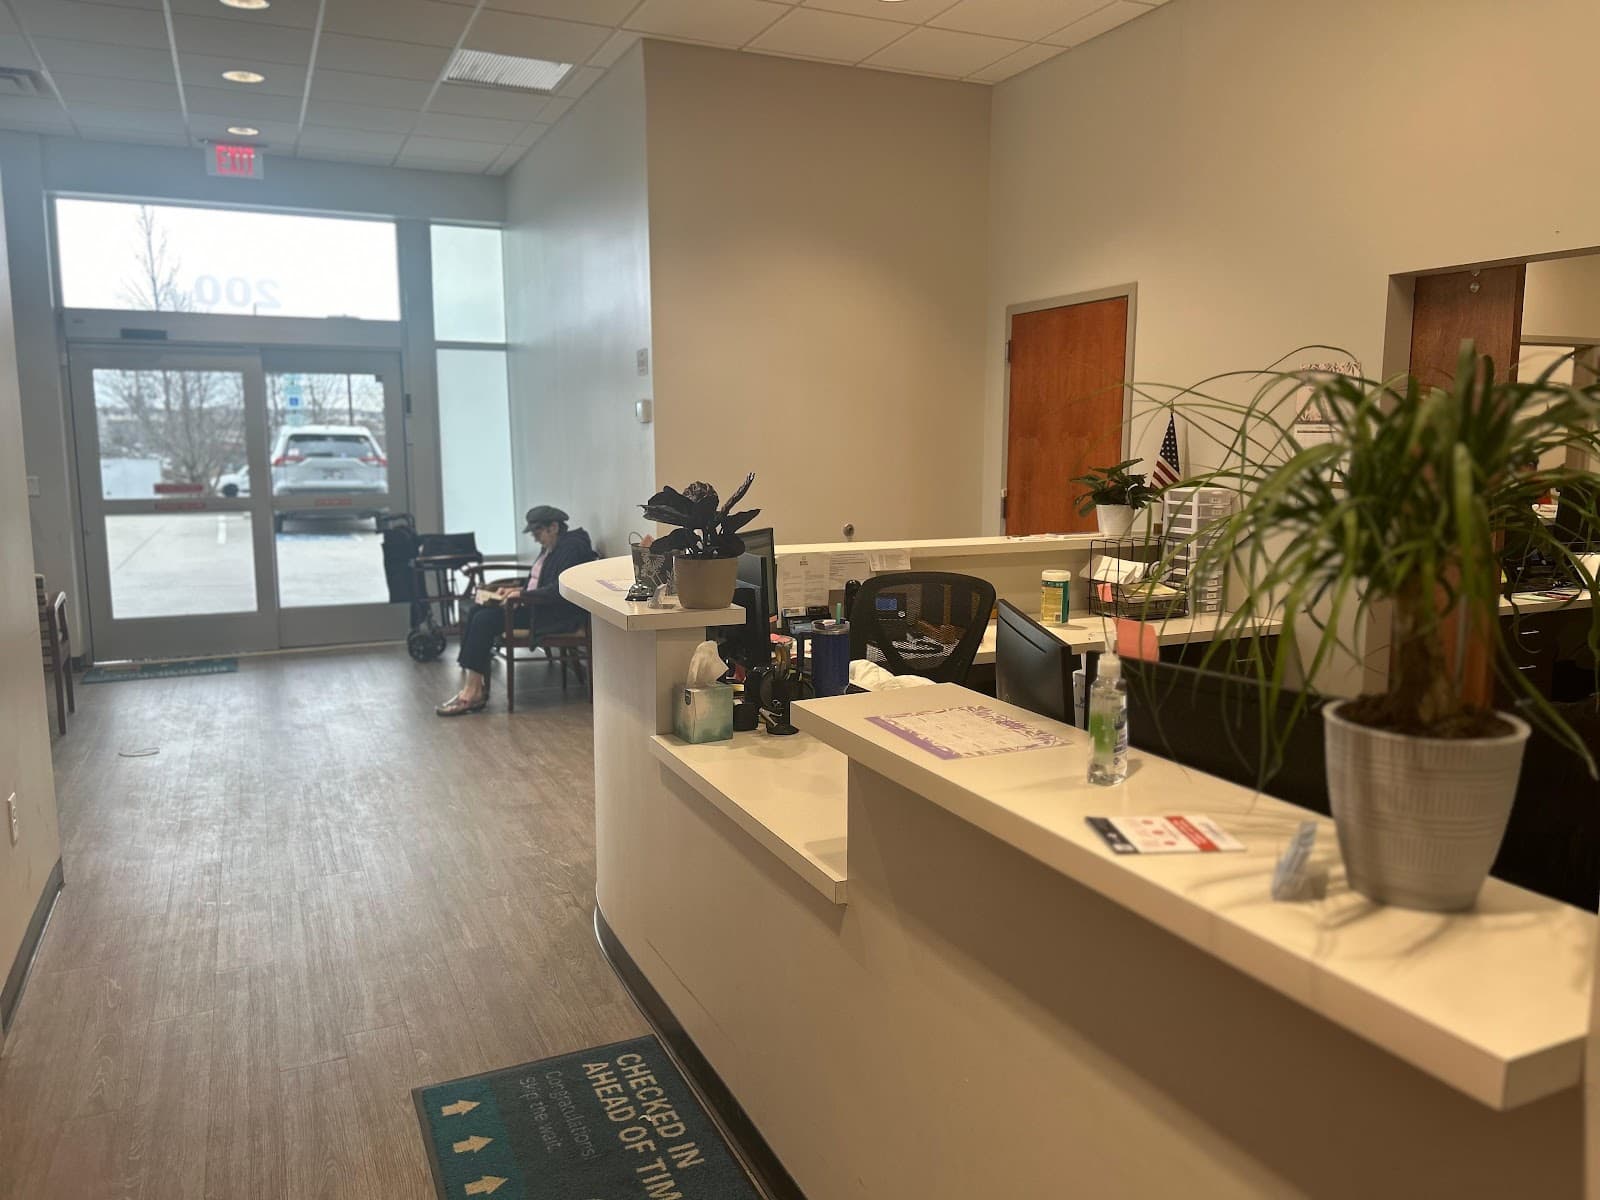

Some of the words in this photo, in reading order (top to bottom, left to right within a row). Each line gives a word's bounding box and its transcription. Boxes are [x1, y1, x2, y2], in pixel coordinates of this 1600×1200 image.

[216, 145, 254, 175] EXIT
[529, 1100, 549, 1121] the
[581, 1062, 637, 1122] AHEAD
[618, 1126, 657, 1153] OF
[616, 1053, 687, 1138] CHECKED
[667, 1142, 705, 1169] IN
